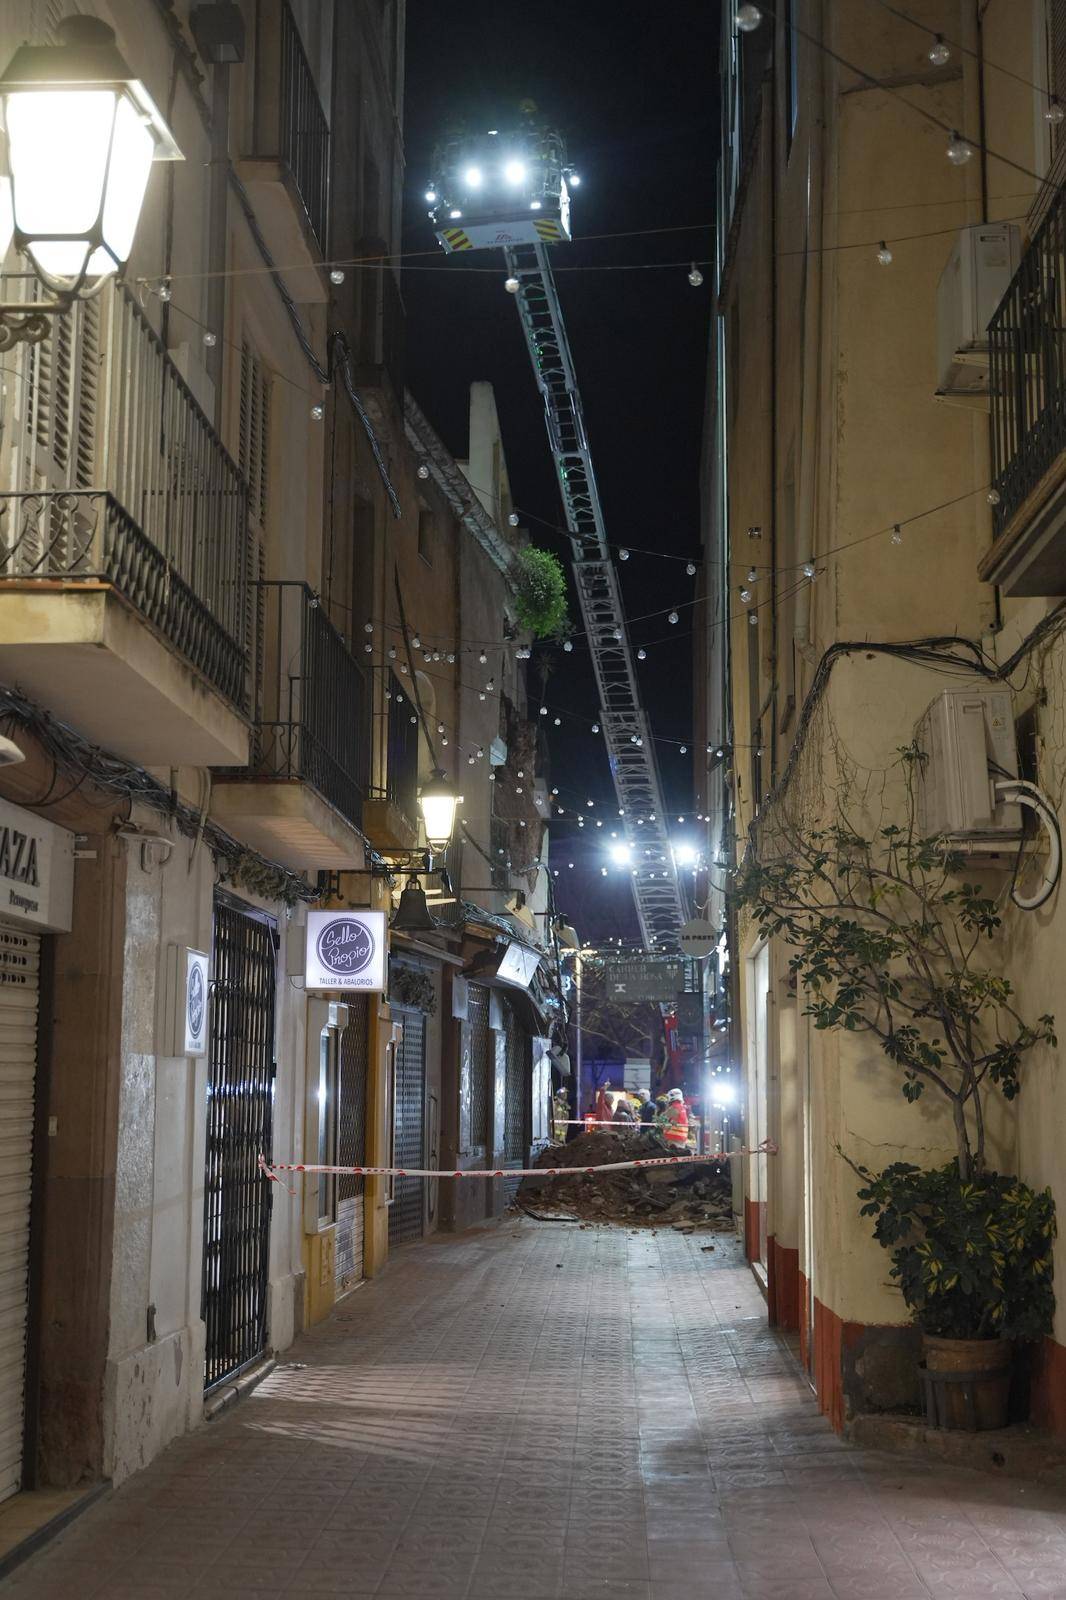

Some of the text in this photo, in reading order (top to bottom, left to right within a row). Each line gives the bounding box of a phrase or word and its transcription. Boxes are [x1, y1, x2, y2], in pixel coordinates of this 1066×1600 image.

[0, 826, 40, 888] AZA
[323, 925, 362, 949] Sello
[328, 946, 370, 967] Propio
